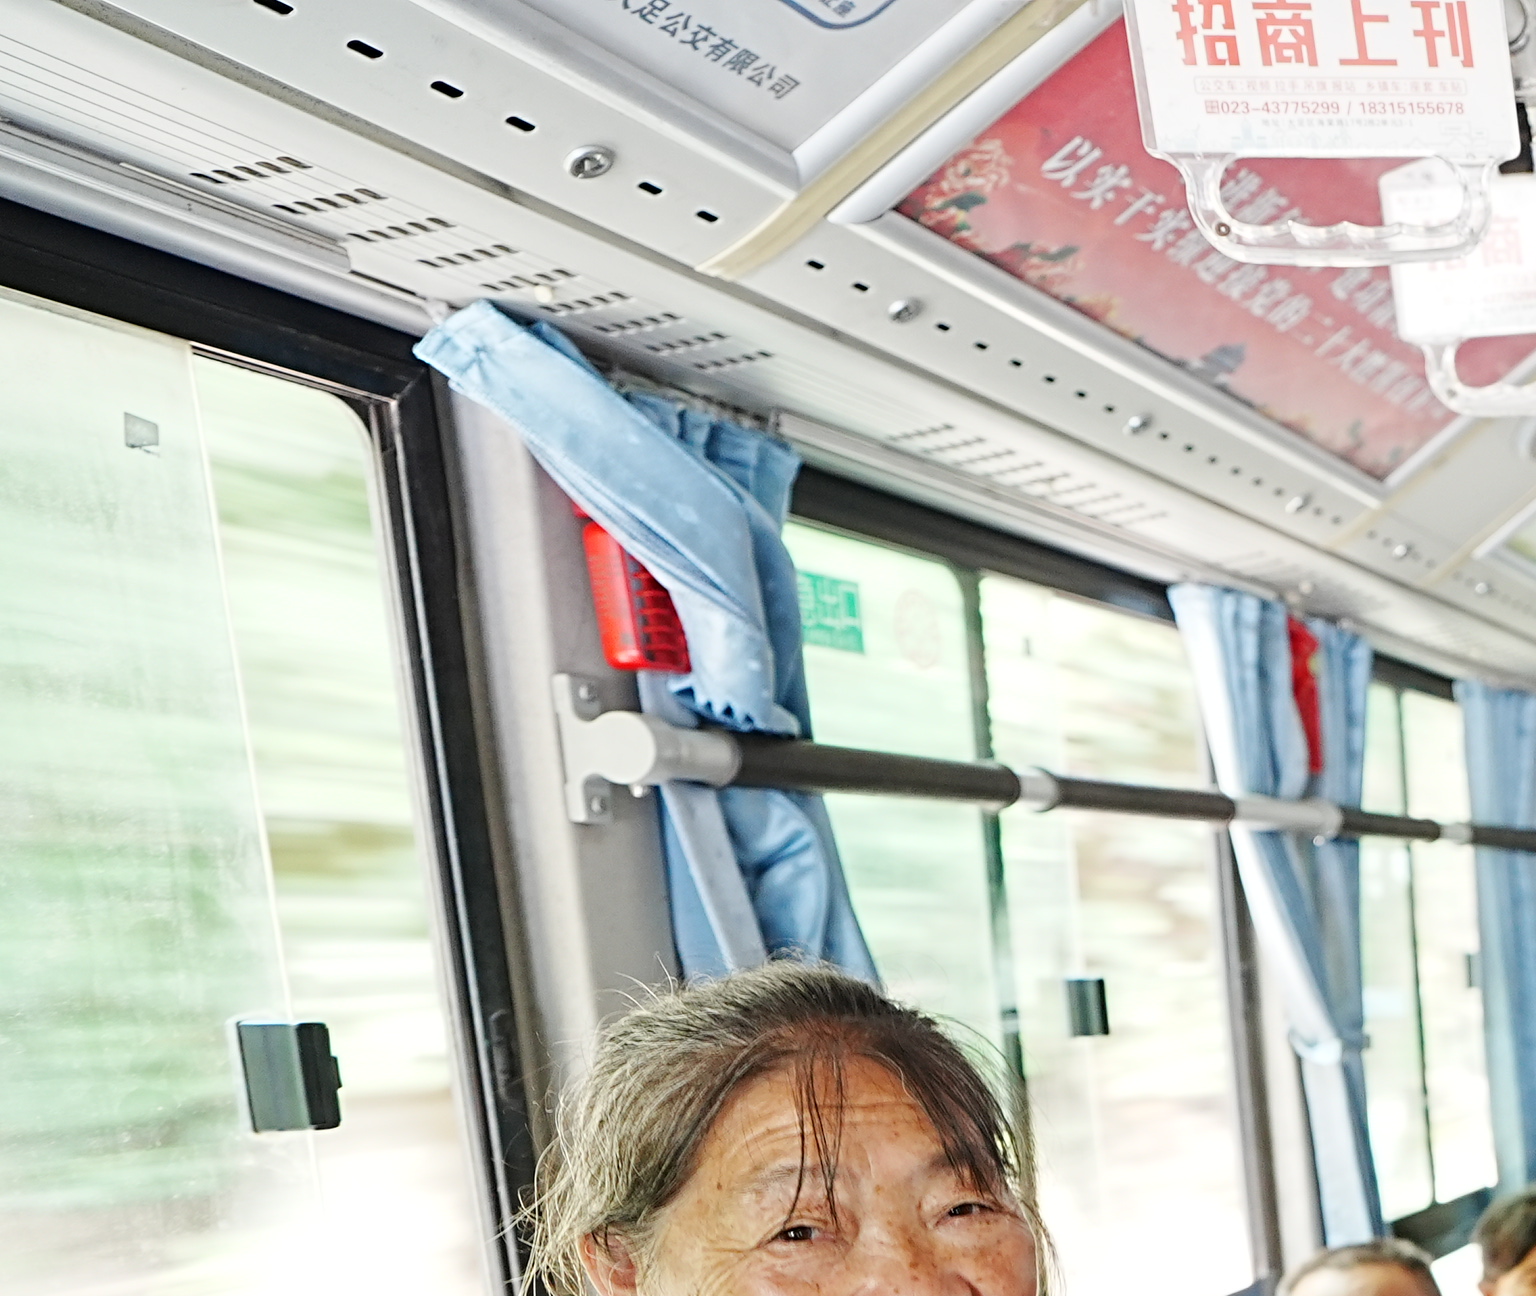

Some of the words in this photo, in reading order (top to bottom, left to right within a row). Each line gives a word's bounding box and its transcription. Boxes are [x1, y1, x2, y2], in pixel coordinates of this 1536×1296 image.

[1171, 0, 1475, 68] 招商上刊
[1221, 101, 1340, 115] 023-43775299
[1359, 101, 1464, 115] 18315155678
